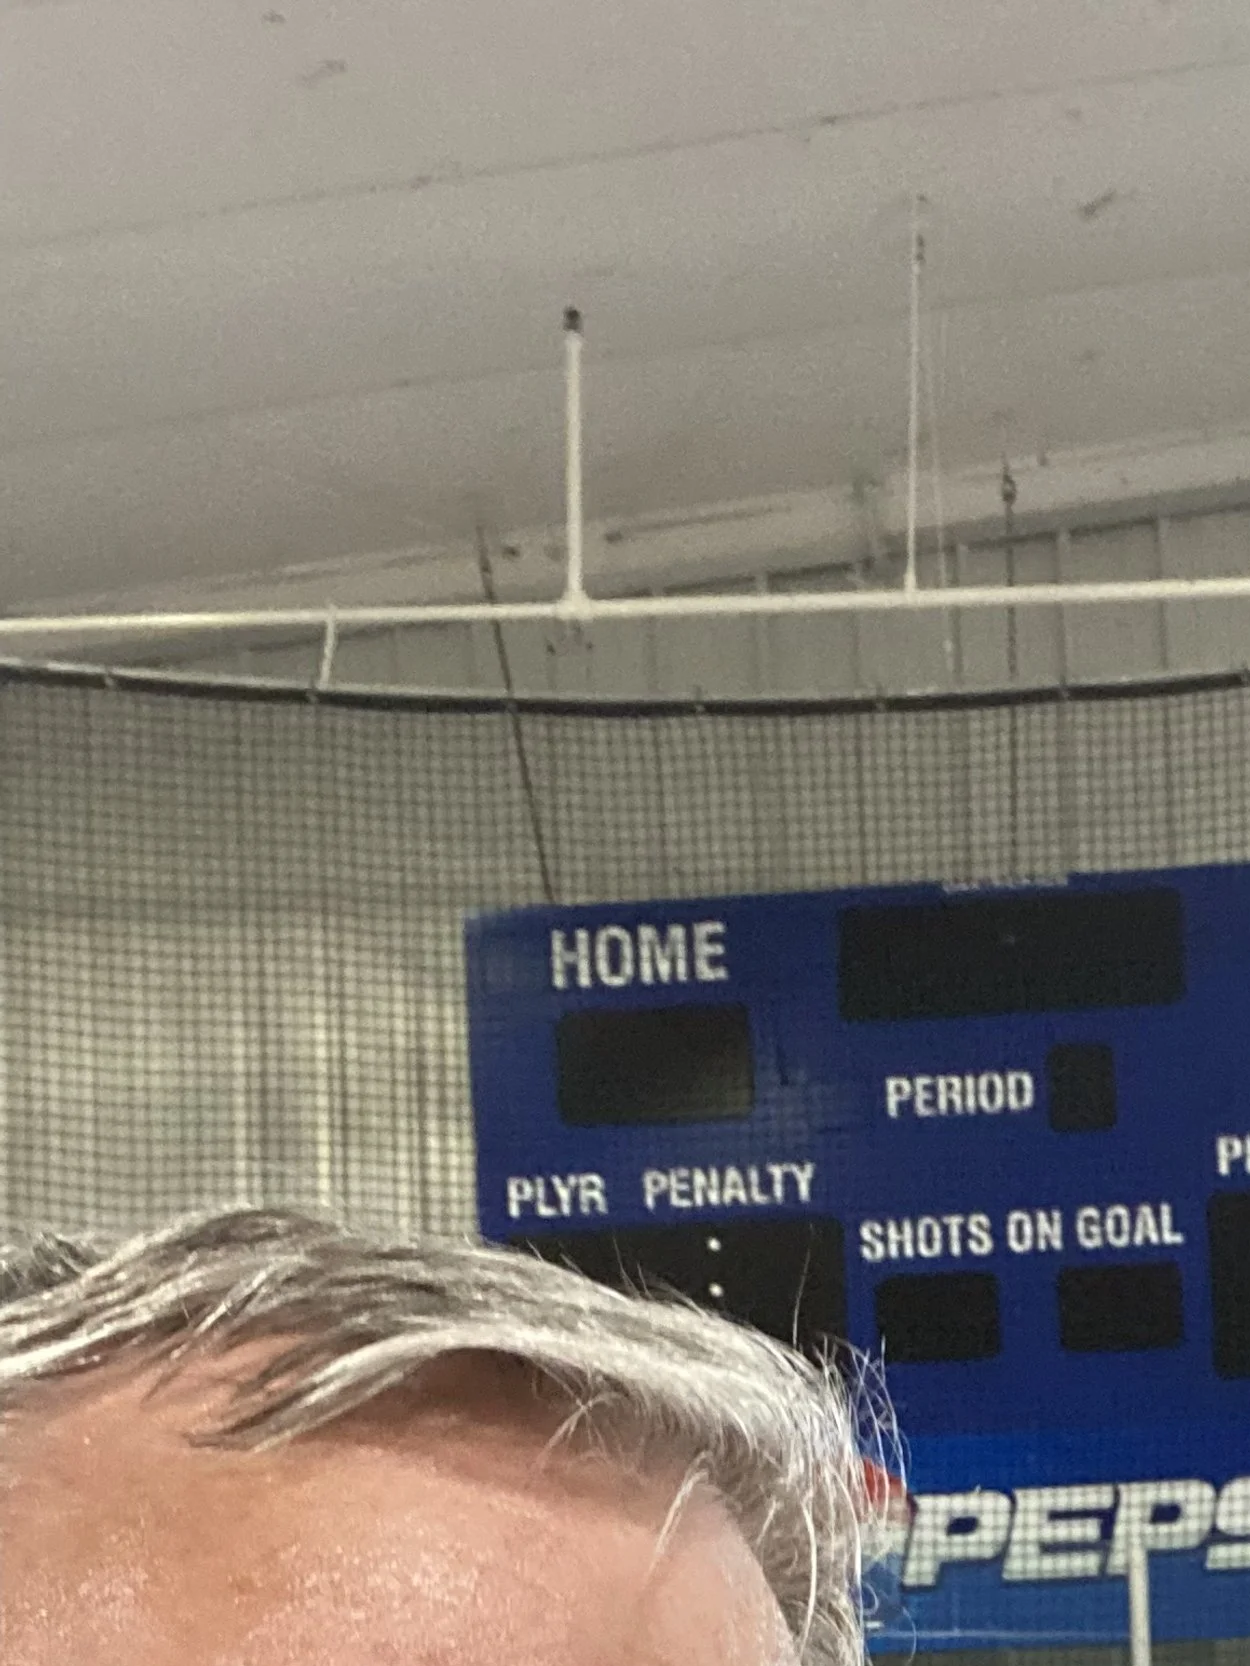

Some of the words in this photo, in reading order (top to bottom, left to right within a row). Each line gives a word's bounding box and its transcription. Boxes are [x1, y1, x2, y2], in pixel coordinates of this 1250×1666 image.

[551, 922, 729, 990] HOME
[885, 1071, 1034, 1119] PERIOD
[507, 1173, 608, 1218] PLYR
[643, 1162, 816, 1211] PENALTY
[860, 1213, 994, 1263] SHOTS
[1007, 1207, 1063, 1252] ON
[1076, 1202, 1185, 1249] GOAL
